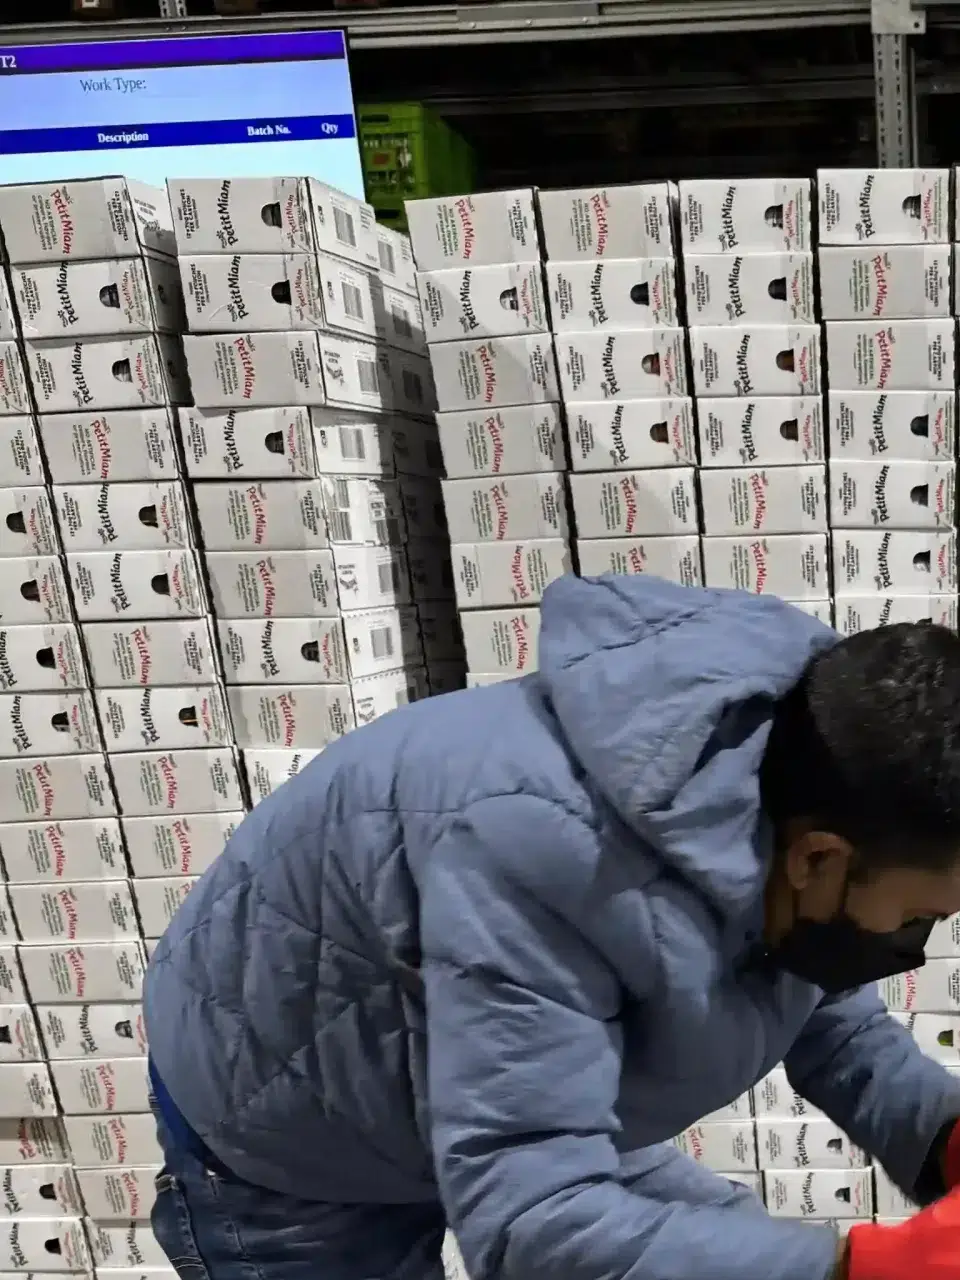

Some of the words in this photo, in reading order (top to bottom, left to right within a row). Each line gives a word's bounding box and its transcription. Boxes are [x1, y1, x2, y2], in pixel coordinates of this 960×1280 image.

[80, 78, 111, 92] Work
[113, 77, 147, 93] Type:
[247, 125, 273, 136] Batch
[275, 125, 291, 135] No.
[321, 122, 338, 135] Qty
[97, 131, 148, 144] Description
